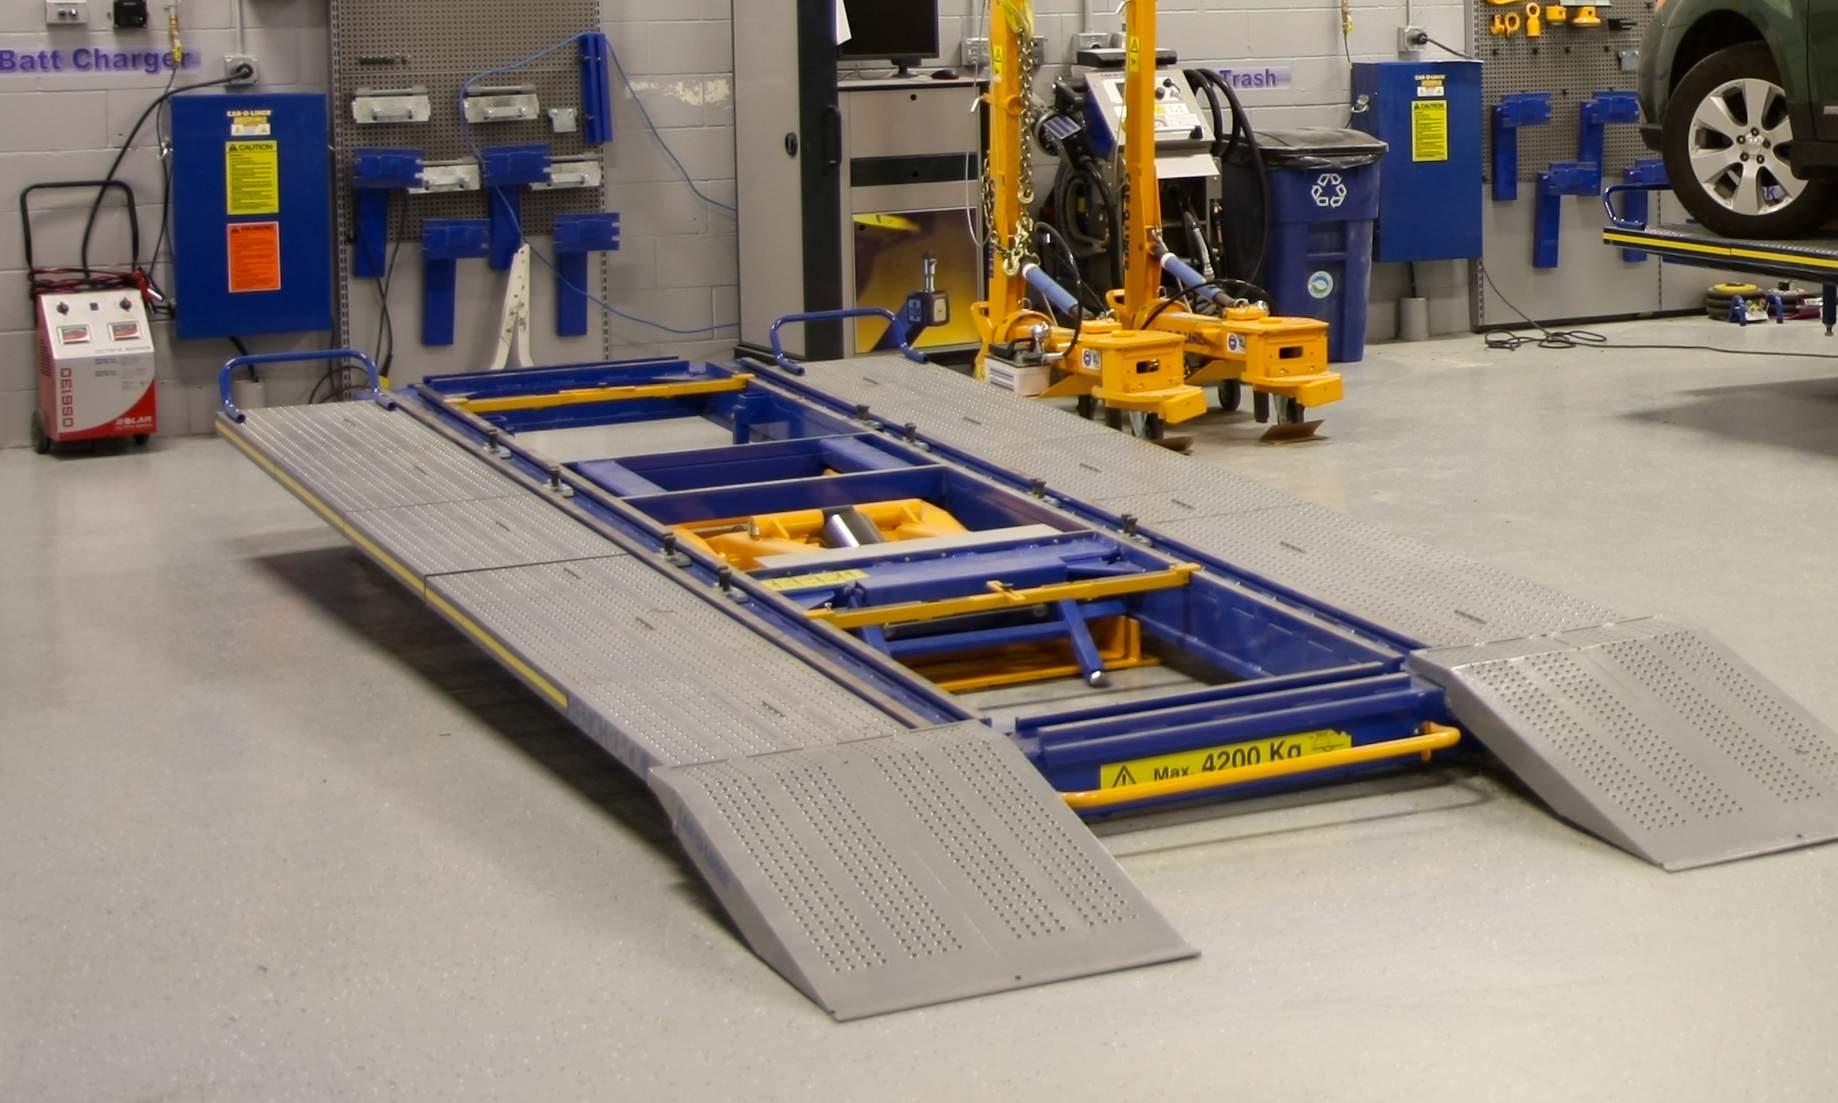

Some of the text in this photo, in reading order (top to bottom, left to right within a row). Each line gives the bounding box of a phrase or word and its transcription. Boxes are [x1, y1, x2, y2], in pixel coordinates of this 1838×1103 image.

[0, 48, 192, 73] Batt Charger
[1219, 68, 1277, 88] Trash
[1202, 746, 1260, 773] 4200
[1269, 740, 1301, 762] Kg
